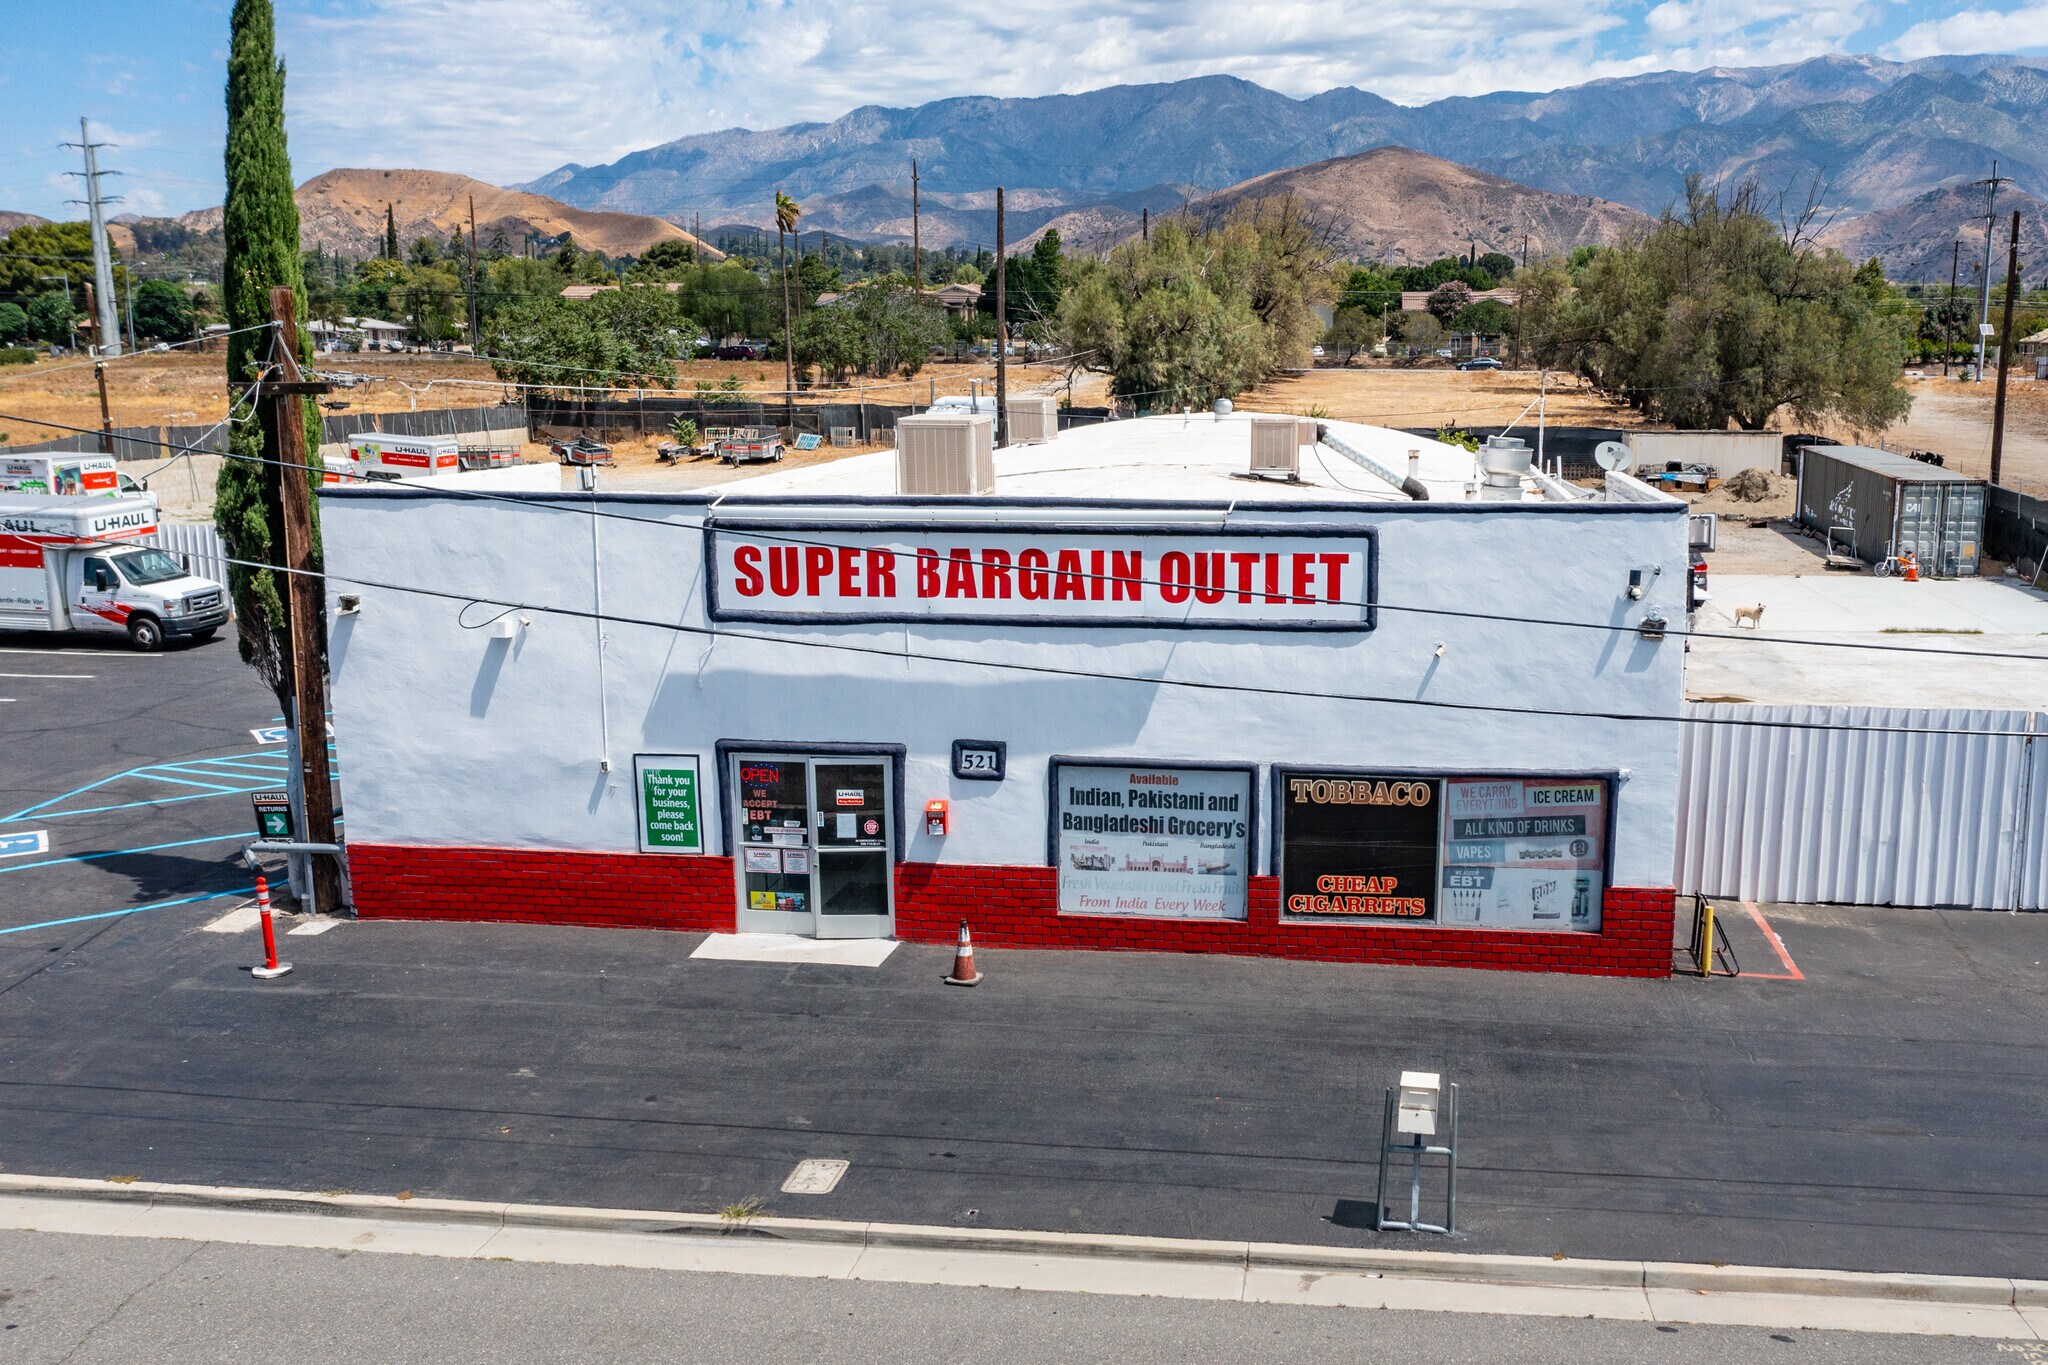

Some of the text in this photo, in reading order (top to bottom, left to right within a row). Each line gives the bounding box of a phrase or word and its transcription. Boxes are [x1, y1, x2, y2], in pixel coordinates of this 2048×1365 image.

[395, 446, 428, 455] U-HAUL
[84, 461, 113, 470] U-HAUL
[0, 519, 41, 532] AUL
[94, 512, 149, 532] U-HAUL
[733, 545, 1350, 604] SUPER BARGAIN OUTLET
[963, 754, 994, 769] 521
[647, 774, 690, 787] Thank you
[740, 768, 779, 782] OPEN
[1130, 773, 1179, 786] Available
[653, 786, 687, 799] for your
[753, 789, 767, 798] WE
[1290, 779, 1431, 807] TOBBACO
[1461, 785, 1512, 798] WE CARRY
[1533, 789, 1594, 804] ICE CREAM
[652, 797, 690, 809] business,
[743, 799, 778, 808] ACCEPT
[1069, 787, 1239, 812] Indian, Pakistani and
[657, 809, 684, 821] please
[749, 810, 772, 820] EBT
[650, 821, 694, 831] come back
[1063, 812, 1245, 839] Bangladeshi Grocery's
[1465, 819, 1575, 835] ALL KIND OF DRINKS
[661, 832, 684, 842] soon!
[1142, 840, 1169, 848] Pakistani
[1200, 842, 1236, 850] Bangladeshi
[1456, 846, 1491, 859] VAPES
[1062, 876, 1092, 889] Fresh
[1094, 877, 1155, 893] Vegetables
[1156, 881, 1179, 893] and
[1181, 881, 1212, 894] Fresh
[1317, 875, 1398, 894] CHEAP
[1450, 875, 1485, 887] EBT
[1079, 895, 1226, 913] From India Every Week
[1288, 894, 1426, 915] CIGARRETS
